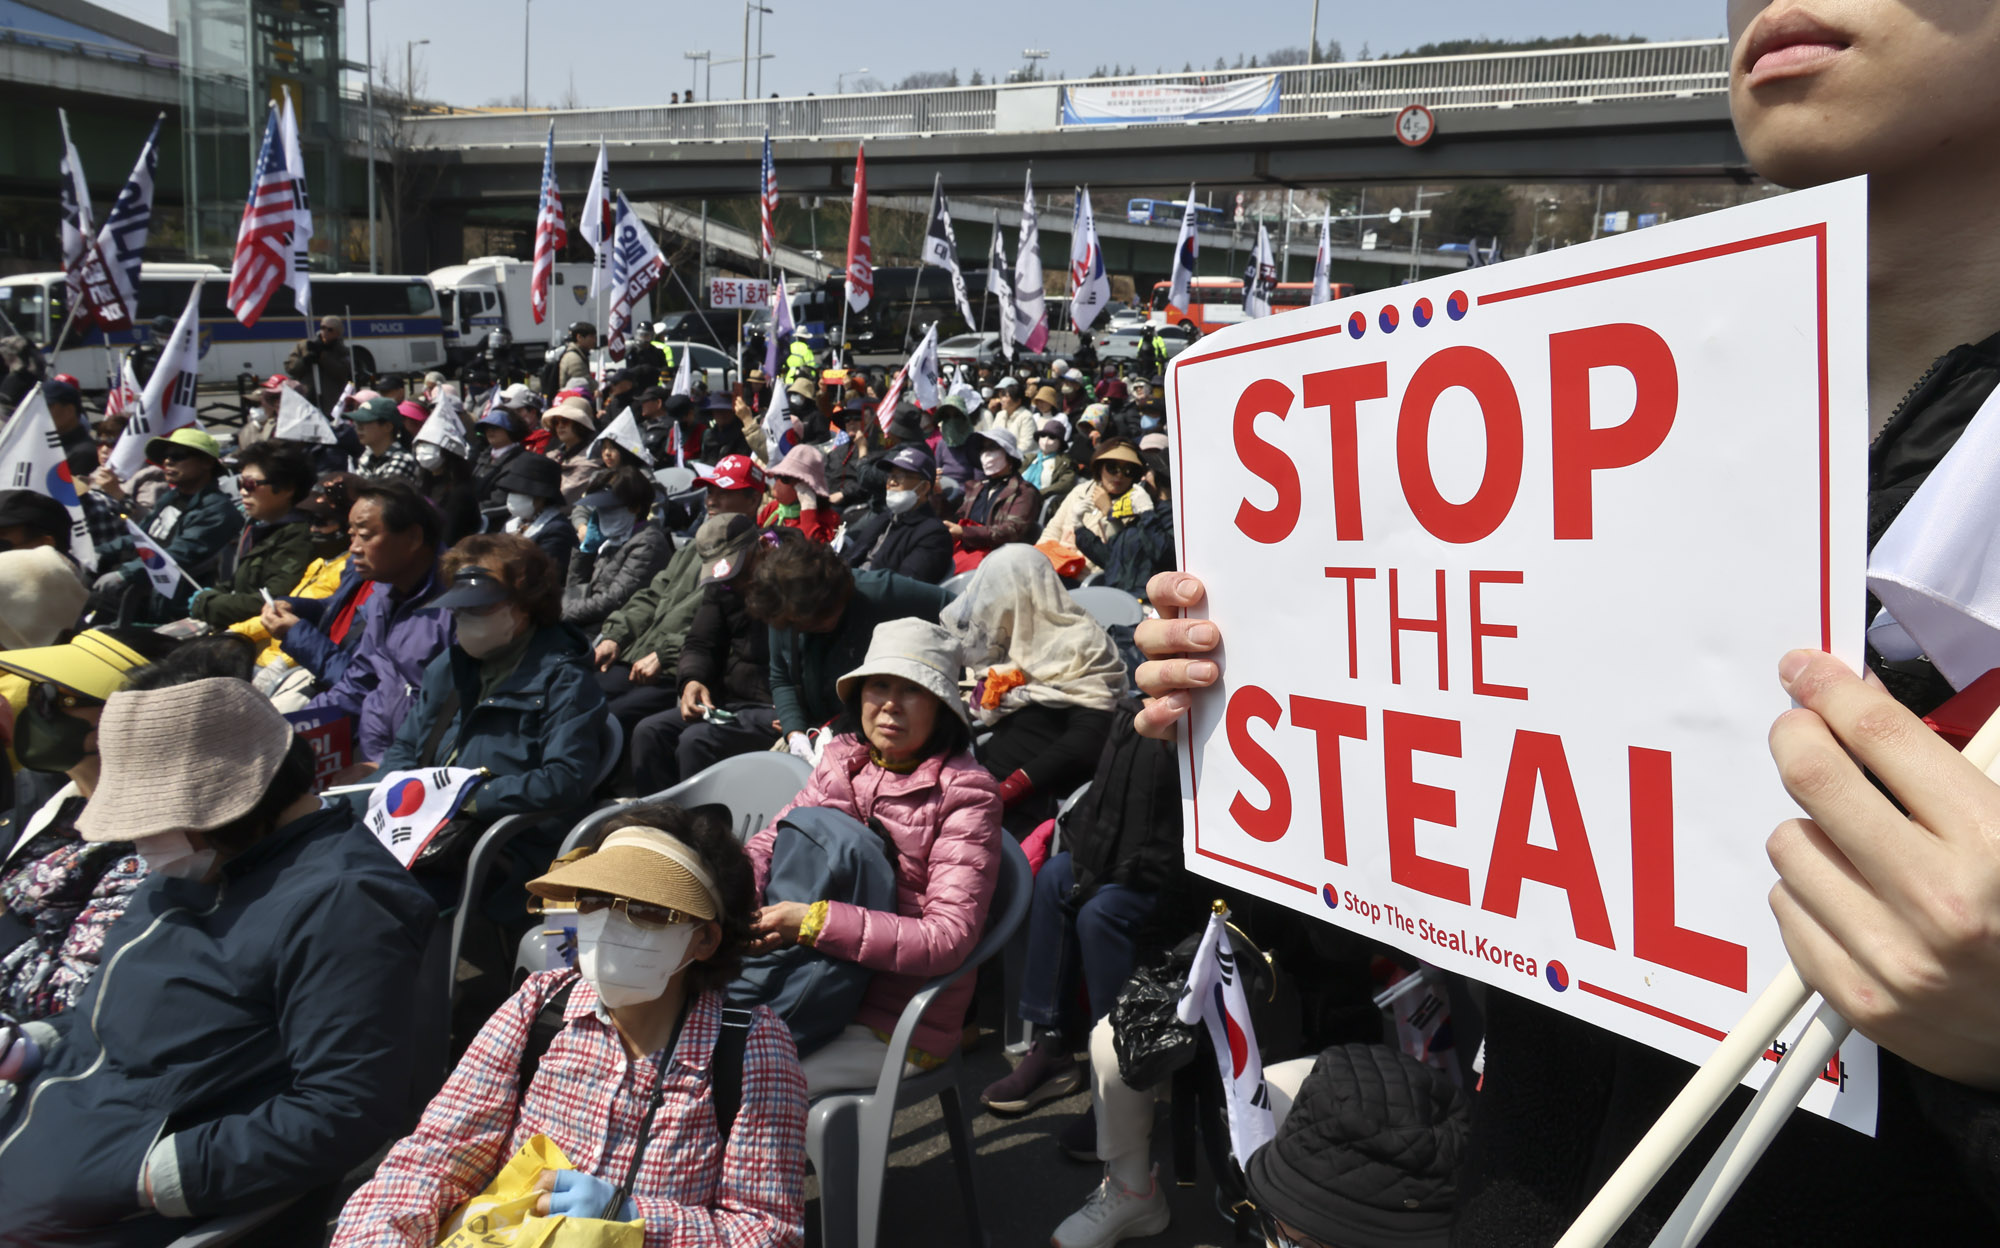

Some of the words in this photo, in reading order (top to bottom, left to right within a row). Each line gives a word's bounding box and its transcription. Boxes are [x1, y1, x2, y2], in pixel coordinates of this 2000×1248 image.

[370, 321, 405, 334] POLICE
[712, 280, 769, 307] 청주1호차
[1232, 322, 1679, 545] STOP
[1324, 566, 1529, 701] THE
[1225, 684, 1748, 994] STEAL
[1344, 890, 1381, 925] Stop
[1384, 903, 1415, 935] The
[1418, 918, 1538, 977] Steal.Korea
